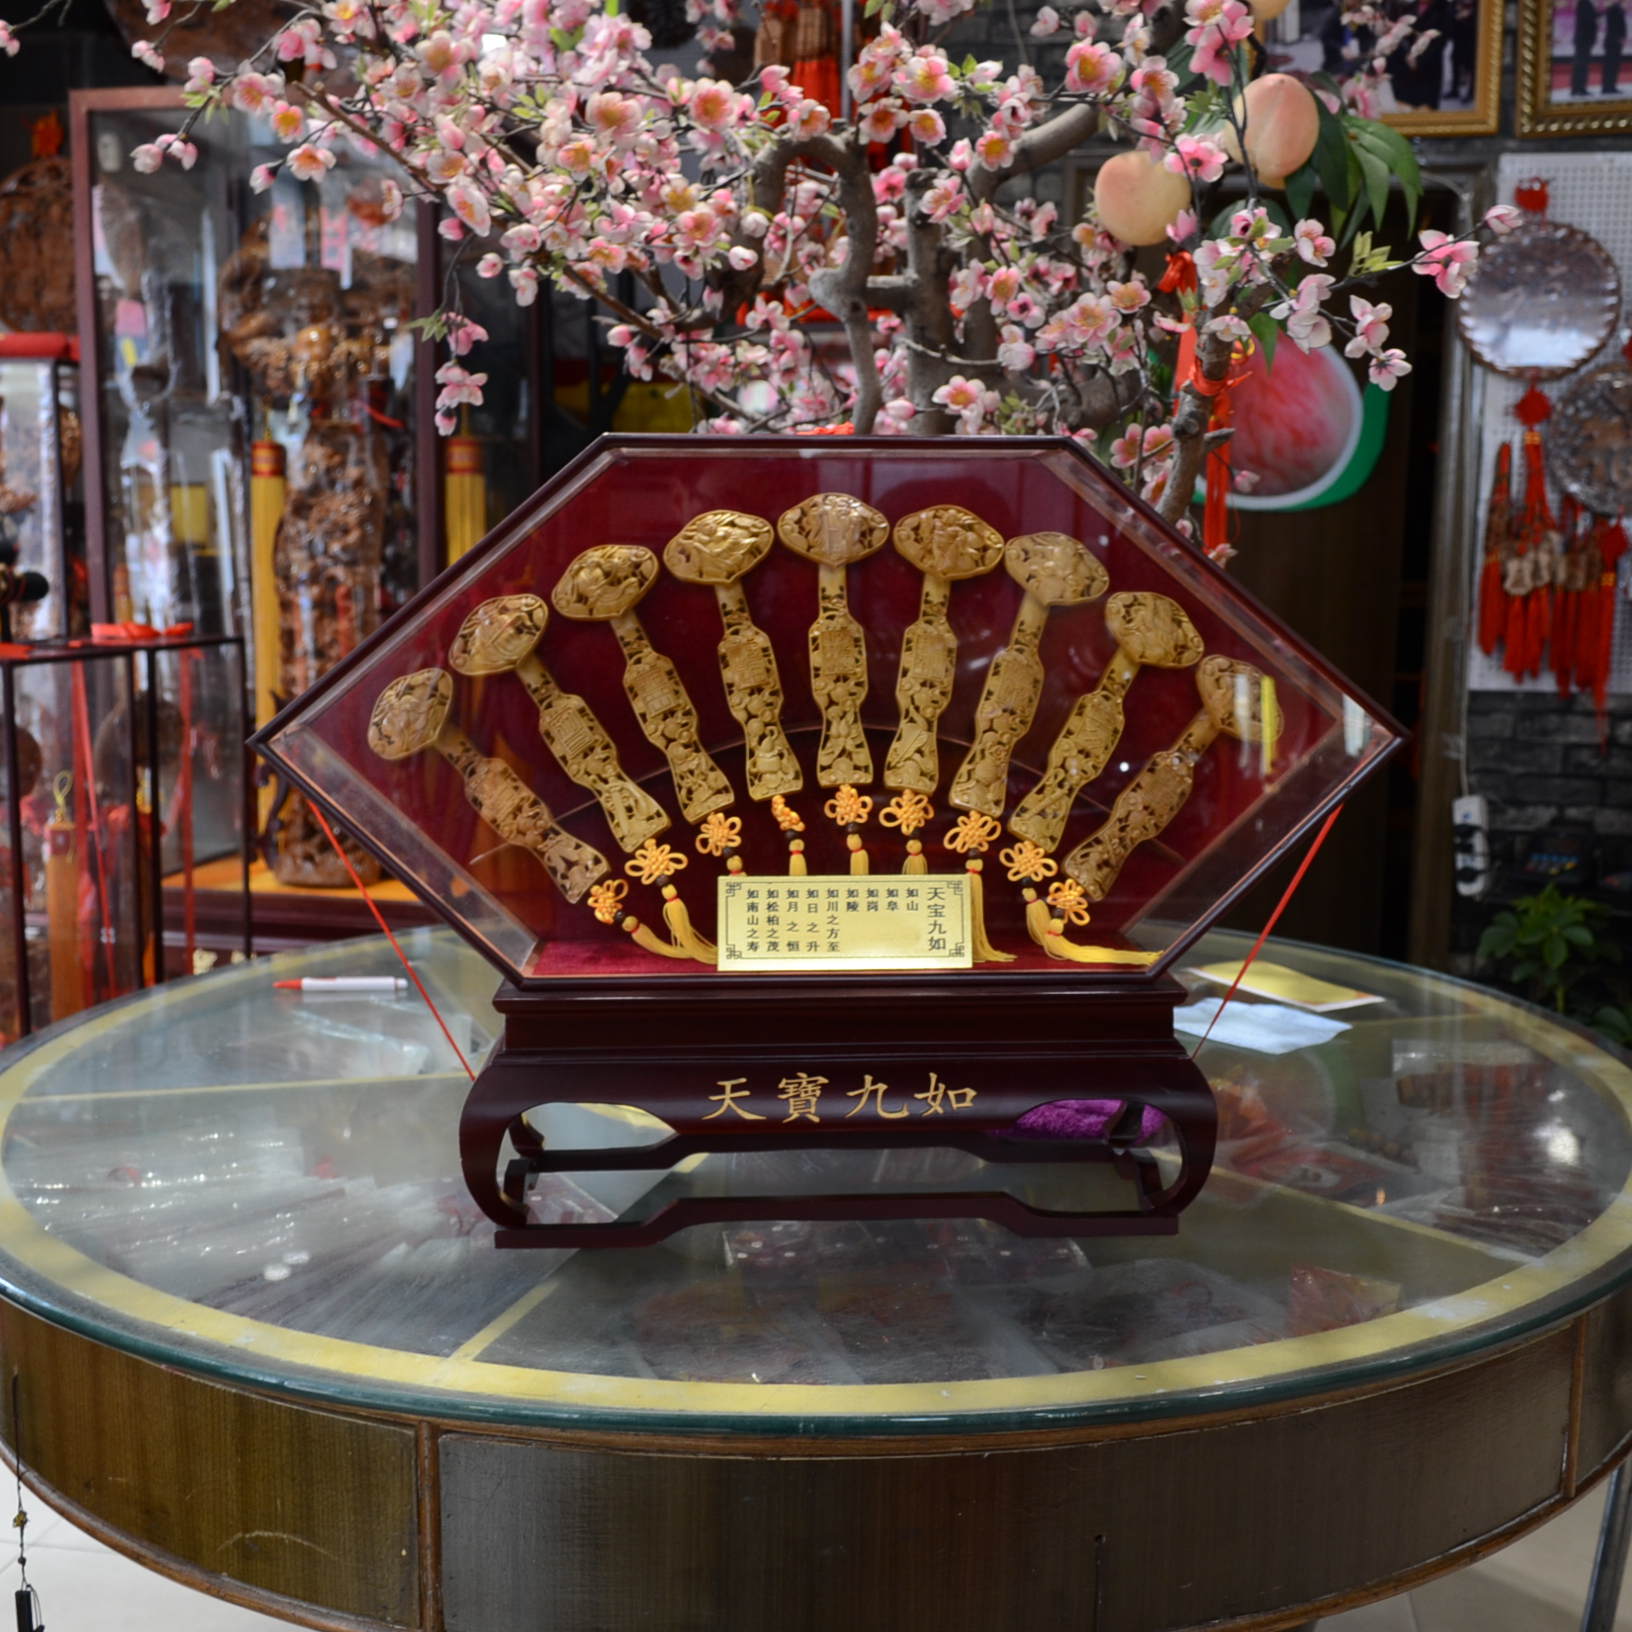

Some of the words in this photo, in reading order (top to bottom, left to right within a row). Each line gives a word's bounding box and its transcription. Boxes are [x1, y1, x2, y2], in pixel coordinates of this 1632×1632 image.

[746, 889, 759, 952] 如南山之寿
[766, 889, 780, 952] 如松柏之茂
[787, 889, 800, 952] 如月之恒
[806, 889, 820, 952] 如日之升
[826, 888, 840, 952] 如川之方至
[846, 888, 859, 912] 如陵
[886, 888, 899, 911] 如阜
[906, 888, 919, 911] 如山
[927, 886, 946, 951] 天宝九如
[702, 1072, 978, 1123] 天寶九如
